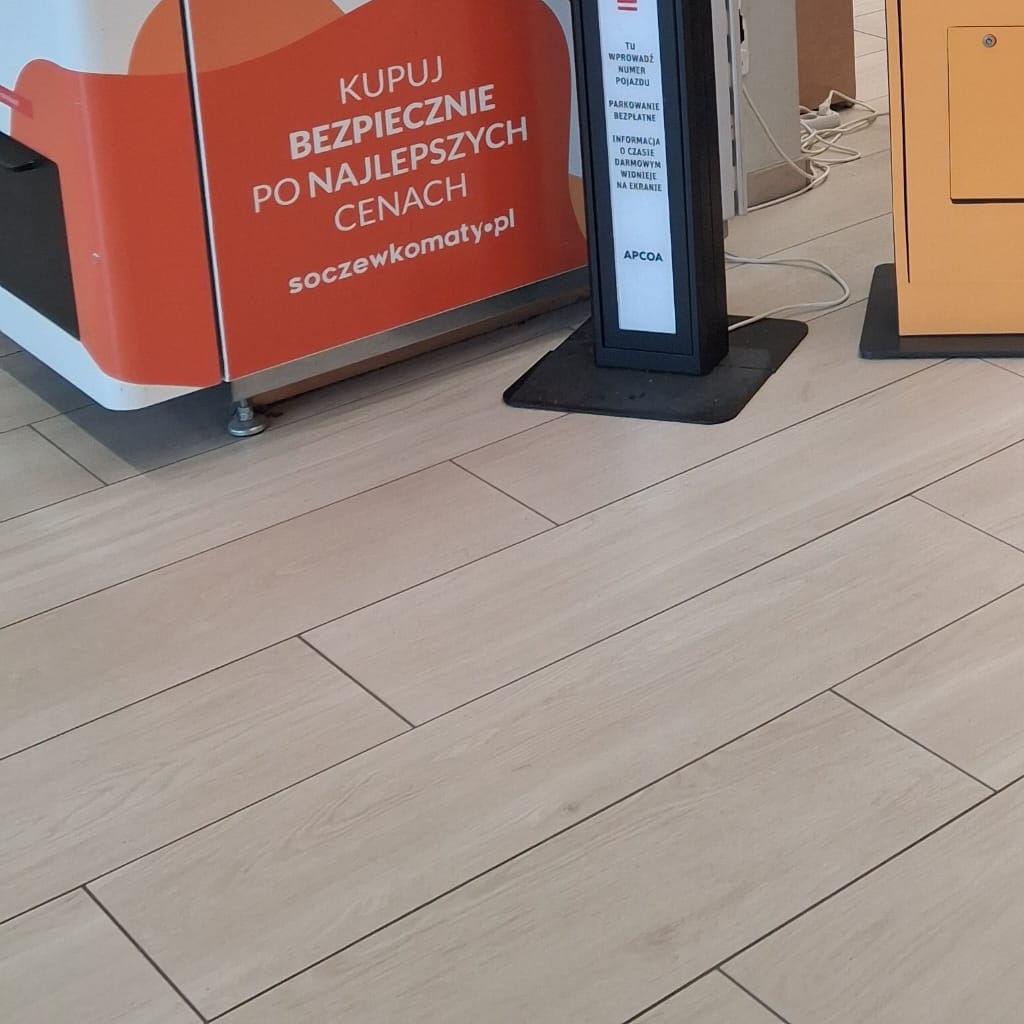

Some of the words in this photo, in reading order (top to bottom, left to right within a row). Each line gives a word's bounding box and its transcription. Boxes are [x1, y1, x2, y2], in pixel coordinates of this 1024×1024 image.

[625, 41, 636, 51] TU
[608, 53, 655, 64] WPROWADŹ
[618, 66, 646, 75] NUMER
[339, 55, 444, 105] KUPUJ
[615, 77, 650, 87] POJAZDU
[608, 99, 661, 111] PARKOWANIE
[289, 83, 496, 161] BEZPIECZNIE
[613, 111, 657, 122] BEZPŁATNE
[612, 134, 661, 146] INFORMACJA
[619, 147, 626, 155] O
[627, 147, 655, 157] CZASIE
[252, 177, 300, 214] PO
[308, 116, 528, 199] NAJLEPSZYCH
[614, 158, 662, 169] DARMOWYM
[620, 169, 657, 180] WIDNIEJE
[616, 181, 628, 189] NA
[629, 181, 663, 192] EKRANIE
[333, 173, 468, 232] CENACH
[623, 249, 664, 263] APCOA
